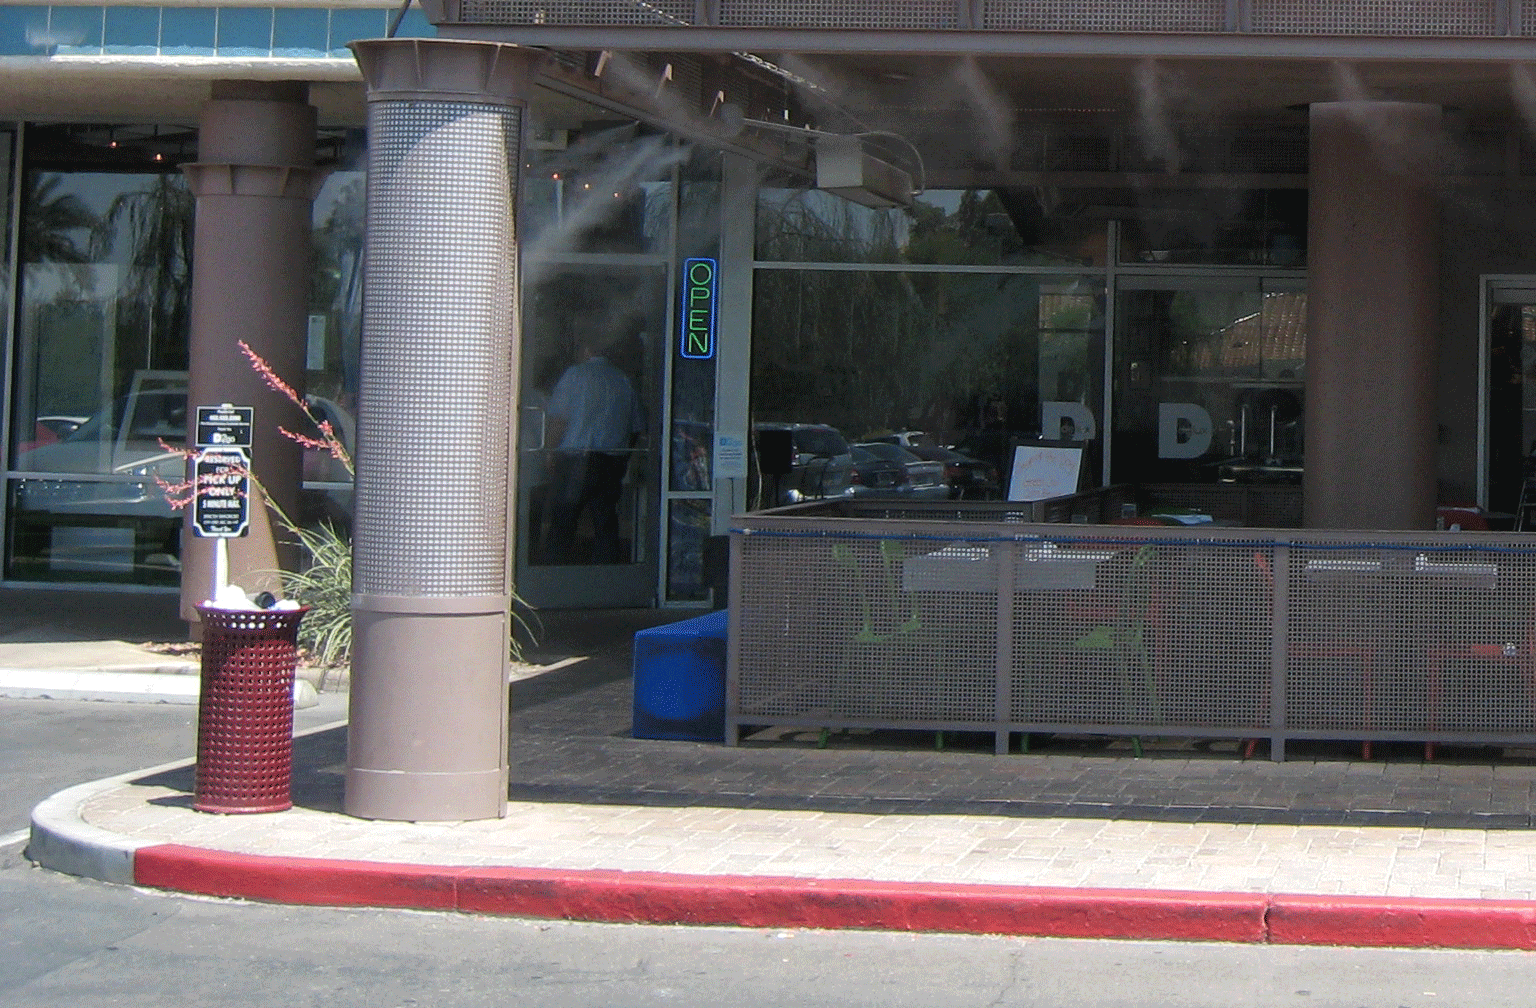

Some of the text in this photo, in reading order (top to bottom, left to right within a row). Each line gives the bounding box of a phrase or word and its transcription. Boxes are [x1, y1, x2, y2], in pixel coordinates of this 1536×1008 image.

[688, 262, 712, 353] OPEN
[1158, 403, 1212, 458] D
[203, 474, 242, 485] PICK UP
[208, 486, 236, 497] ONLY
